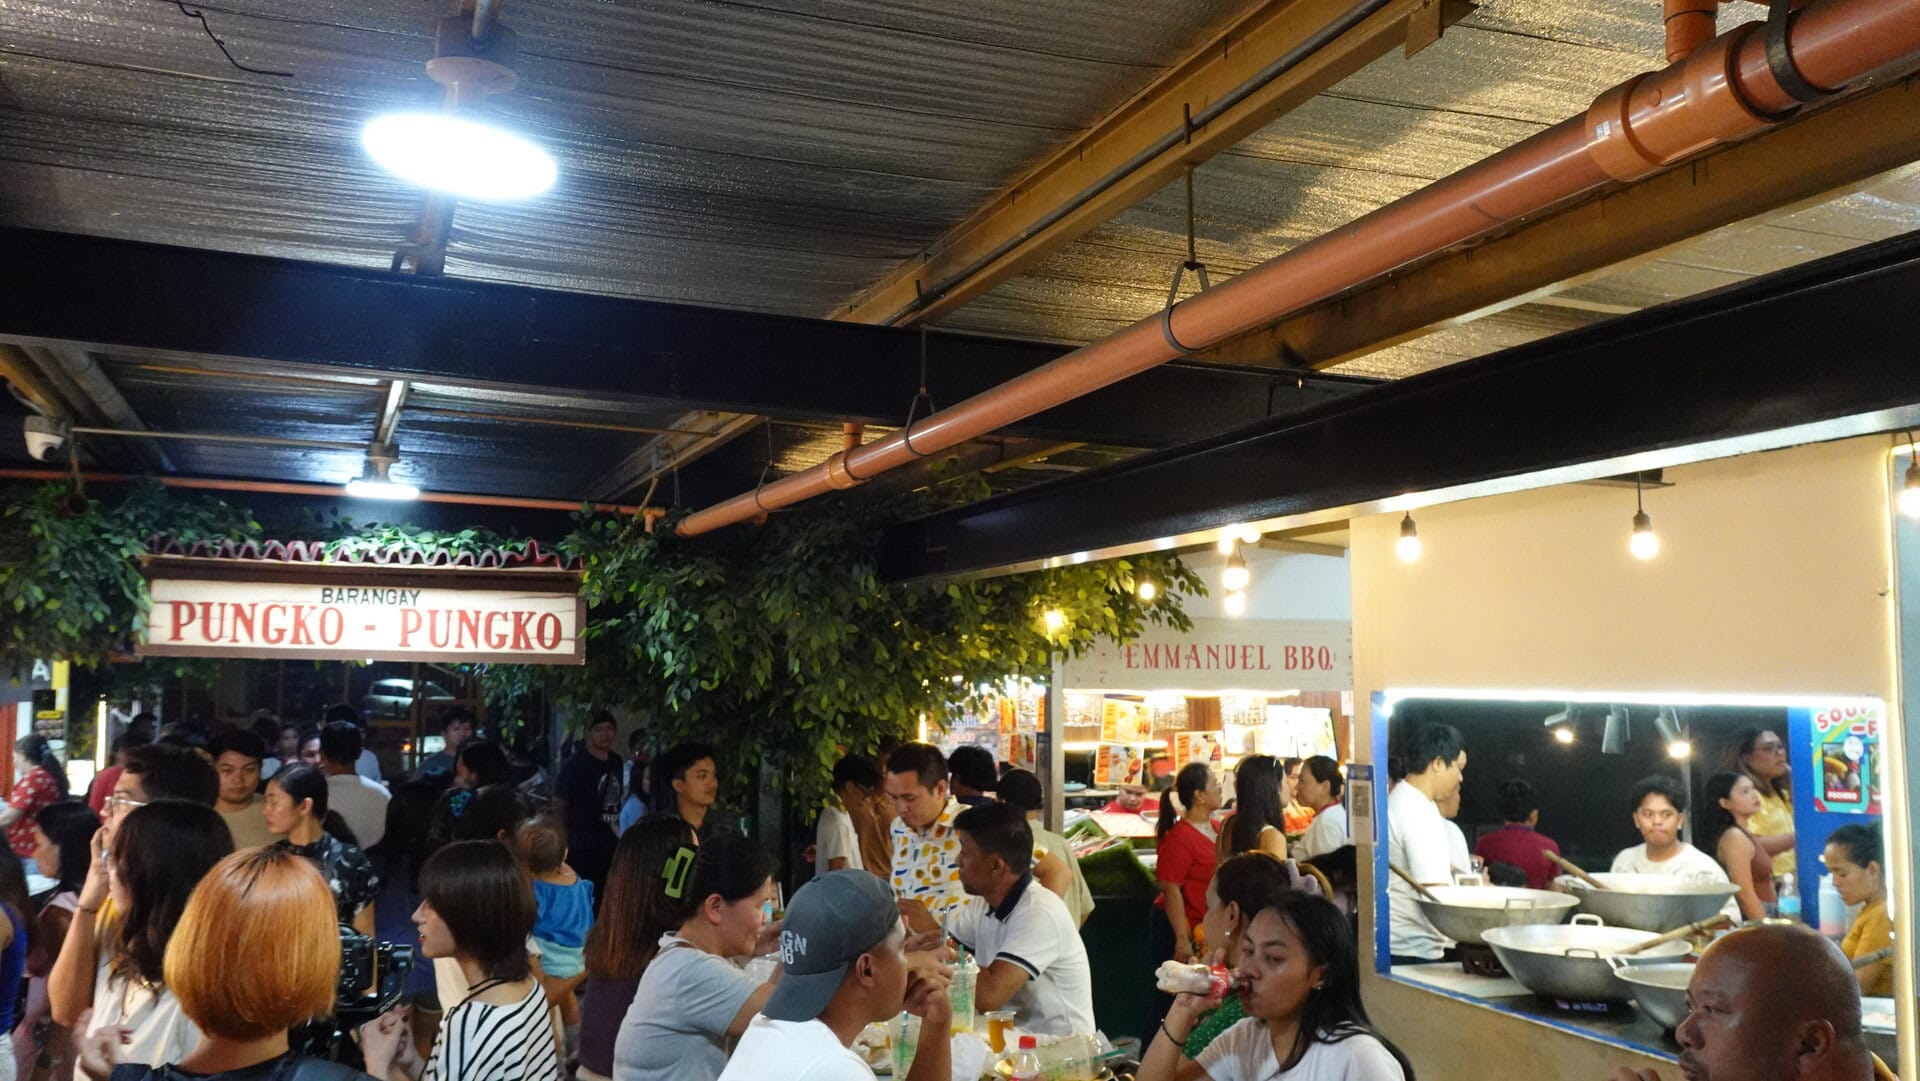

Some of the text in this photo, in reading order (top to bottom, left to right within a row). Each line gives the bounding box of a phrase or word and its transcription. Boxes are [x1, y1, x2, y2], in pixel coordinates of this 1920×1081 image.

[321, 587, 421, 606] BARANGAY
[168, 600, 345, 646] PUNGKO
[398, 608, 563, 650] PUNGKO
[1124, 643, 1334, 671] EMMANUEL BBQ
